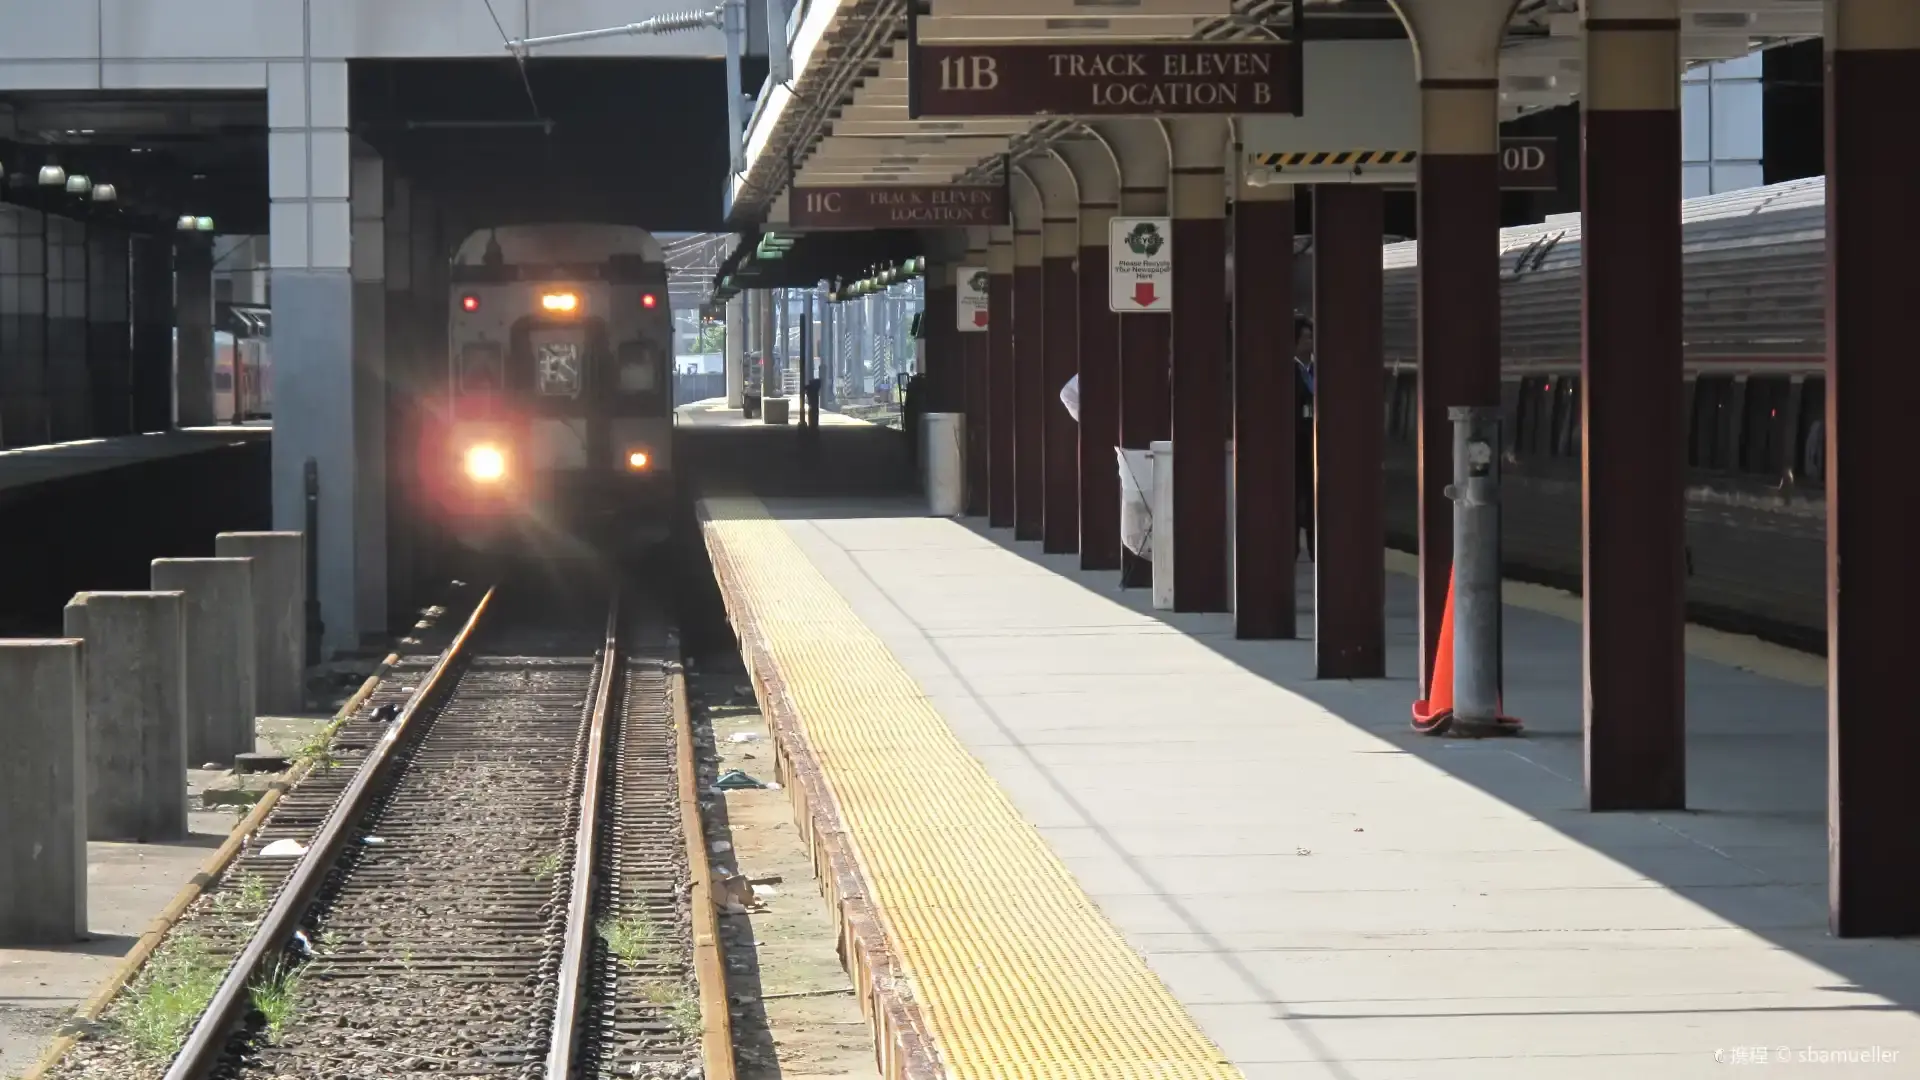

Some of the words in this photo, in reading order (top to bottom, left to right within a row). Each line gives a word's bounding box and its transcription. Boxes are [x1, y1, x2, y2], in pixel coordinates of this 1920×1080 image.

[939, 55, 999, 91] 11B
[1049, 54, 1147, 76] TRACK
[1163, 53, 1271, 76] ELEVEN
[1092, 83, 1238, 106] LOCATION
[1253, 82, 1272, 105] B
[1502, 146, 1545, 171] 0D
[805, 192, 842, 213] 11C
[869, 192, 922, 204] TRACK
[932, 191, 992, 204] ELEVEN
[891, 207, 974, 221] LOCATION
[981, 207, 993, 219] C
